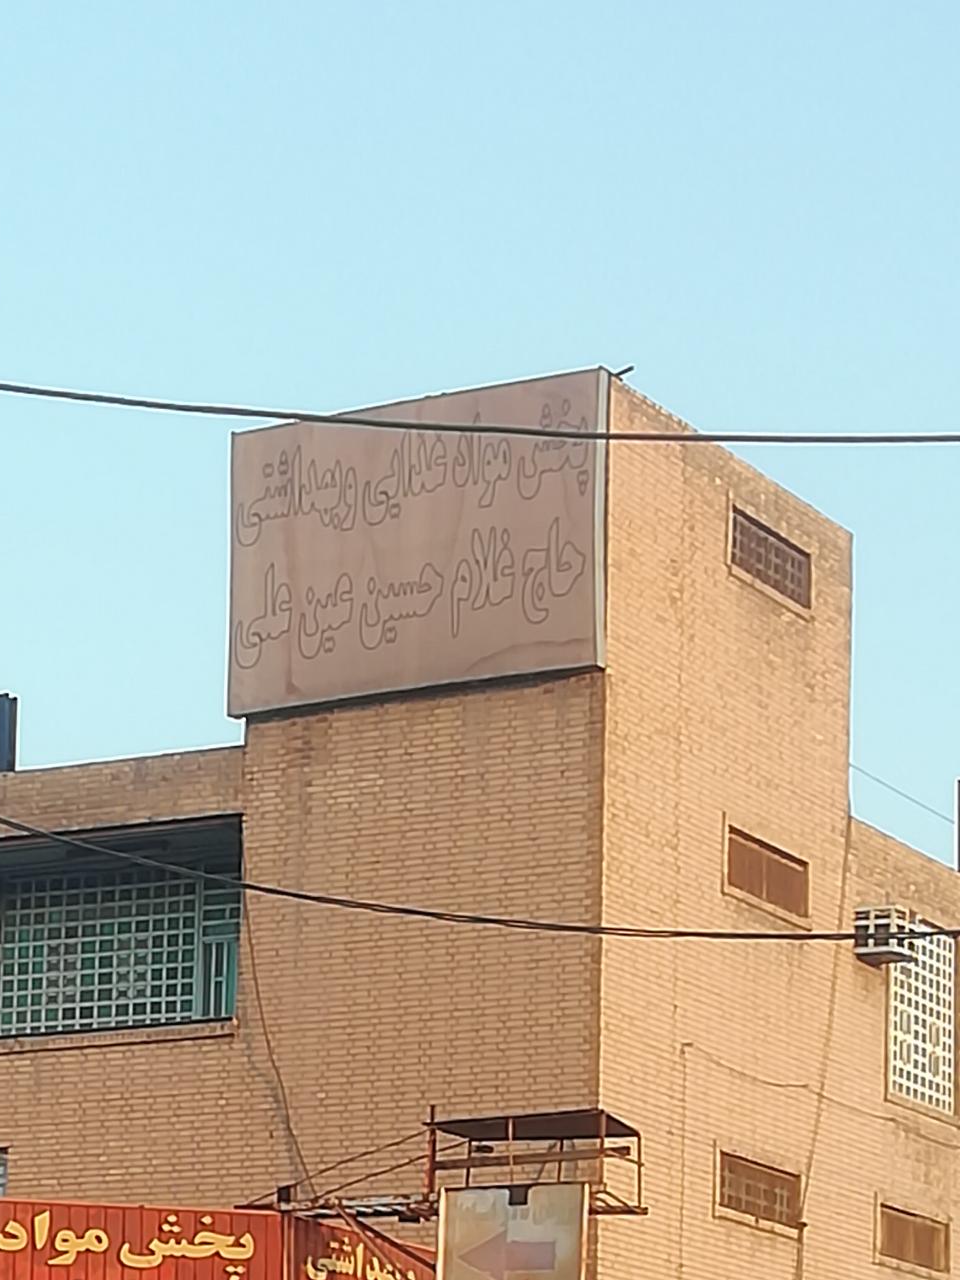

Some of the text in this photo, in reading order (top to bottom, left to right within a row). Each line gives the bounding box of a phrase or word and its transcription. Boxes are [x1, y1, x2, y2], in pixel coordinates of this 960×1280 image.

[452, 410, 512, 508] مواد
[235, 516, 586, 670] حاج غلام حسین عین علی
